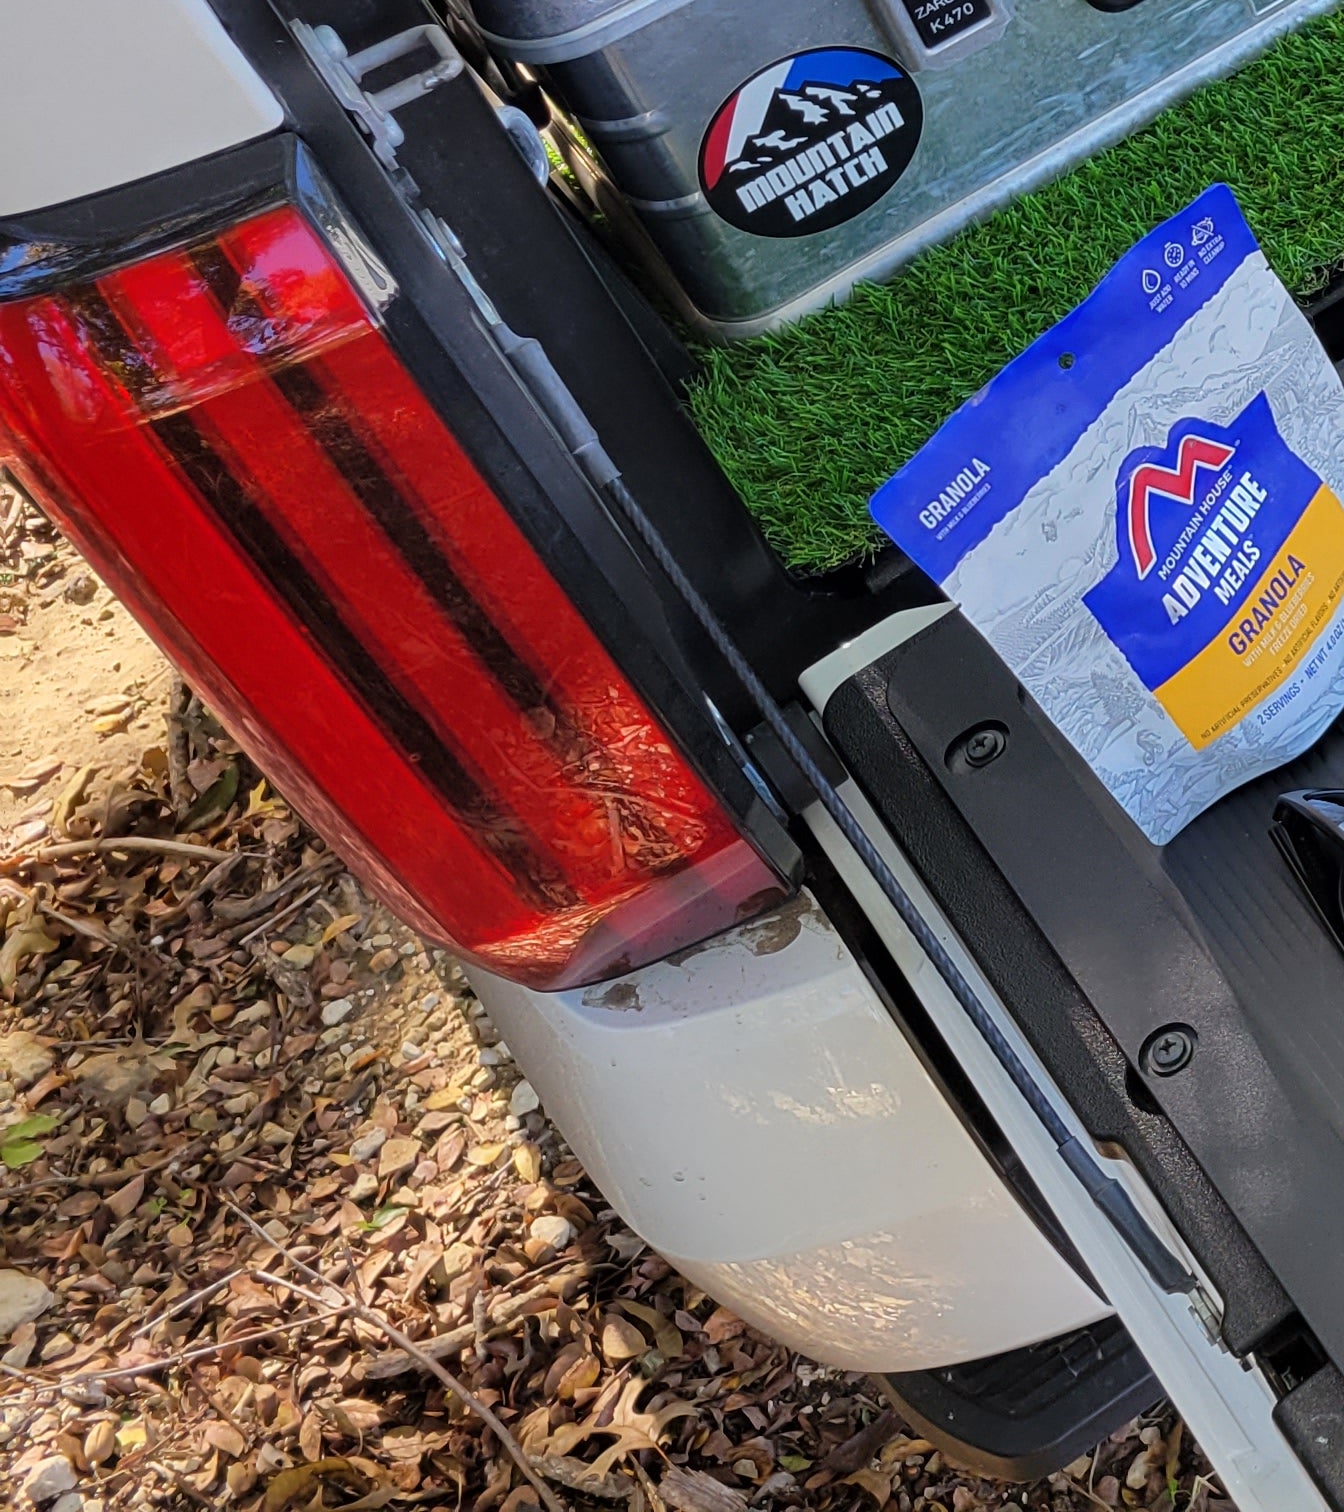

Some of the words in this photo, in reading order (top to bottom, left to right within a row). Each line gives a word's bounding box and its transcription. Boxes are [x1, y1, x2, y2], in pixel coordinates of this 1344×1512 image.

[929, 0, 976, 35] K470
[735, 100, 906, 215] MOUNTAIN
[783, 145, 889, 223] HATCH
[919, 457, 991, 530] GRANOLA
[1158, 512, 1204, 581] MOUNTAIN
[1198, 468, 1234, 522] HOUSE
[1161, 471, 1268, 626] ADVENTURE
[1213, 539, 1262, 606] MEALS
[1227, 554, 1307, 656] GRANOLA
[1211, 707, 1241, 735] ARTIFICIAL
[1240, 666, 1283, 708] PRESERVATIVES
[1290, 628, 1313, 656] ARTIFICIAL
[1242, 645, 1262, 668] WITH
[1257, 713, 1265, 726] 2
[1263, 684, 1301, 722] SERVINGS
